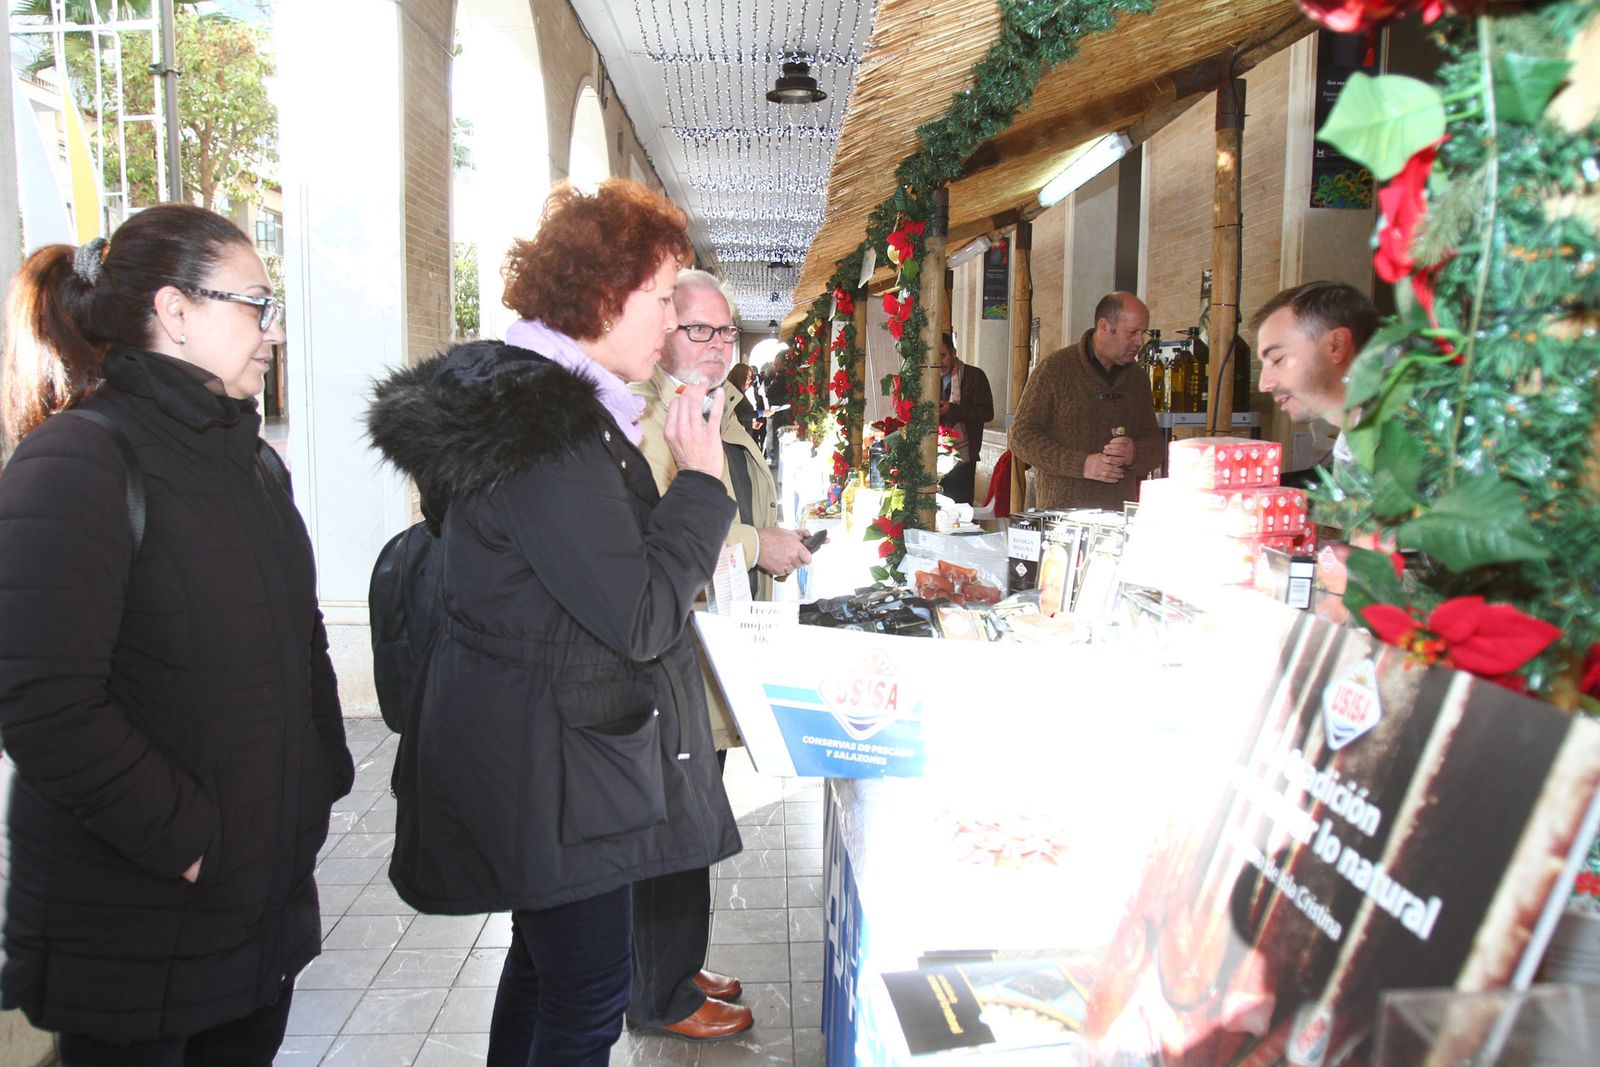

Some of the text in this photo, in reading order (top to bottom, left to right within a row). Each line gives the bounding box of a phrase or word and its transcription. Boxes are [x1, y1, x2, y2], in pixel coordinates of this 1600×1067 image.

[835, 677, 898, 711] USISA
[1331, 684, 1372, 722] USISA
[801, 735, 857, 750] CONSERVAS
[858, 742, 871, 752] DE
[825, 750, 888, 766] Y SALAZONES
[1313, 820, 1341, 863] lo
[1335, 848, 1444, 940] natural
[1296, 886, 1342, 941] Cristina
